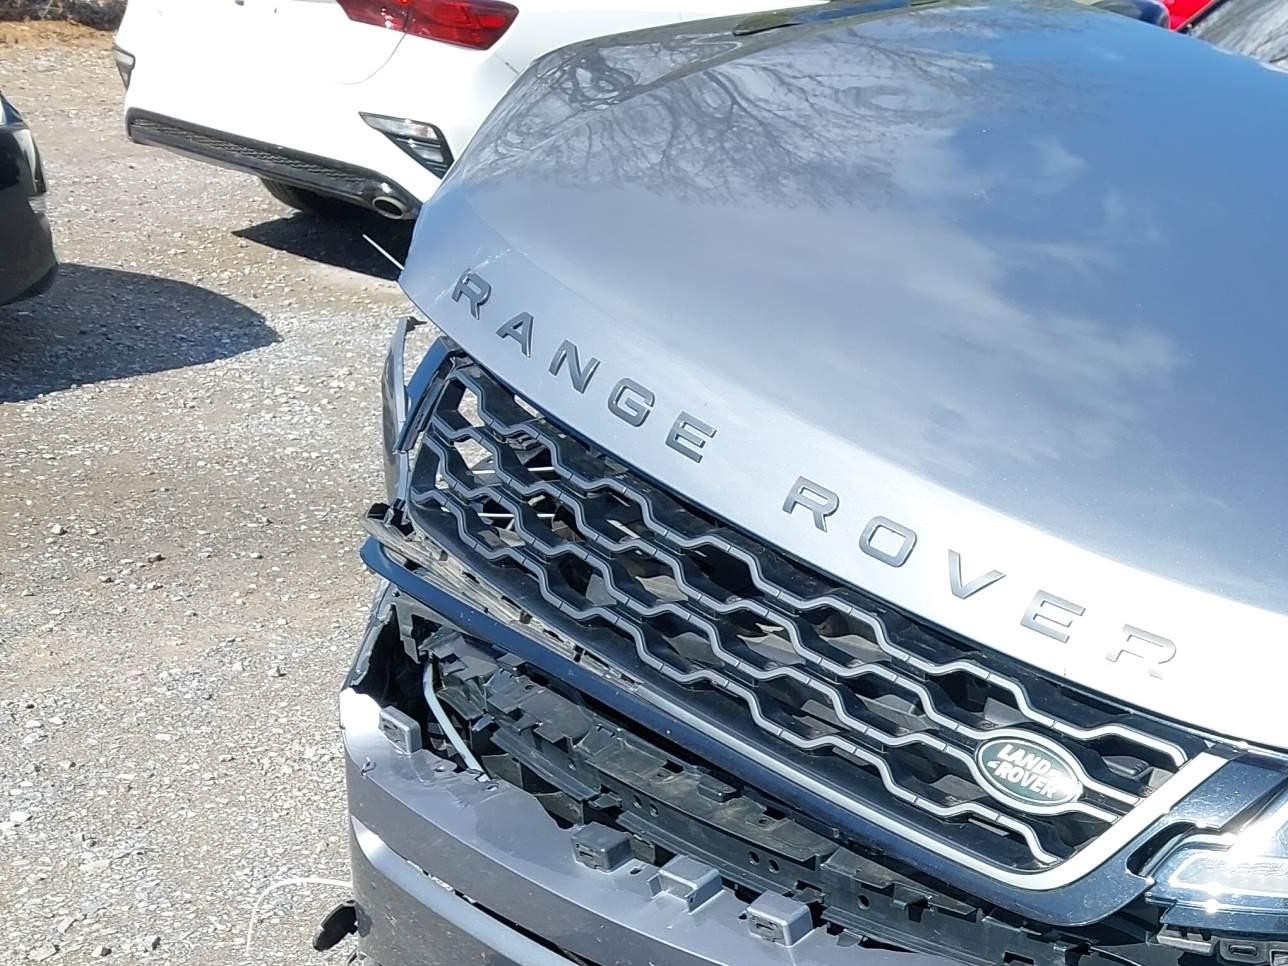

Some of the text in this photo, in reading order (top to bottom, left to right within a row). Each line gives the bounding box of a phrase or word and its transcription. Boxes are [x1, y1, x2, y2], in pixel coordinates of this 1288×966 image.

[451, 269, 1178, 680] RANGE ROVER
[997, 743, 1052, 775] LAND
[994, 761, 1056, 799] ROVER
